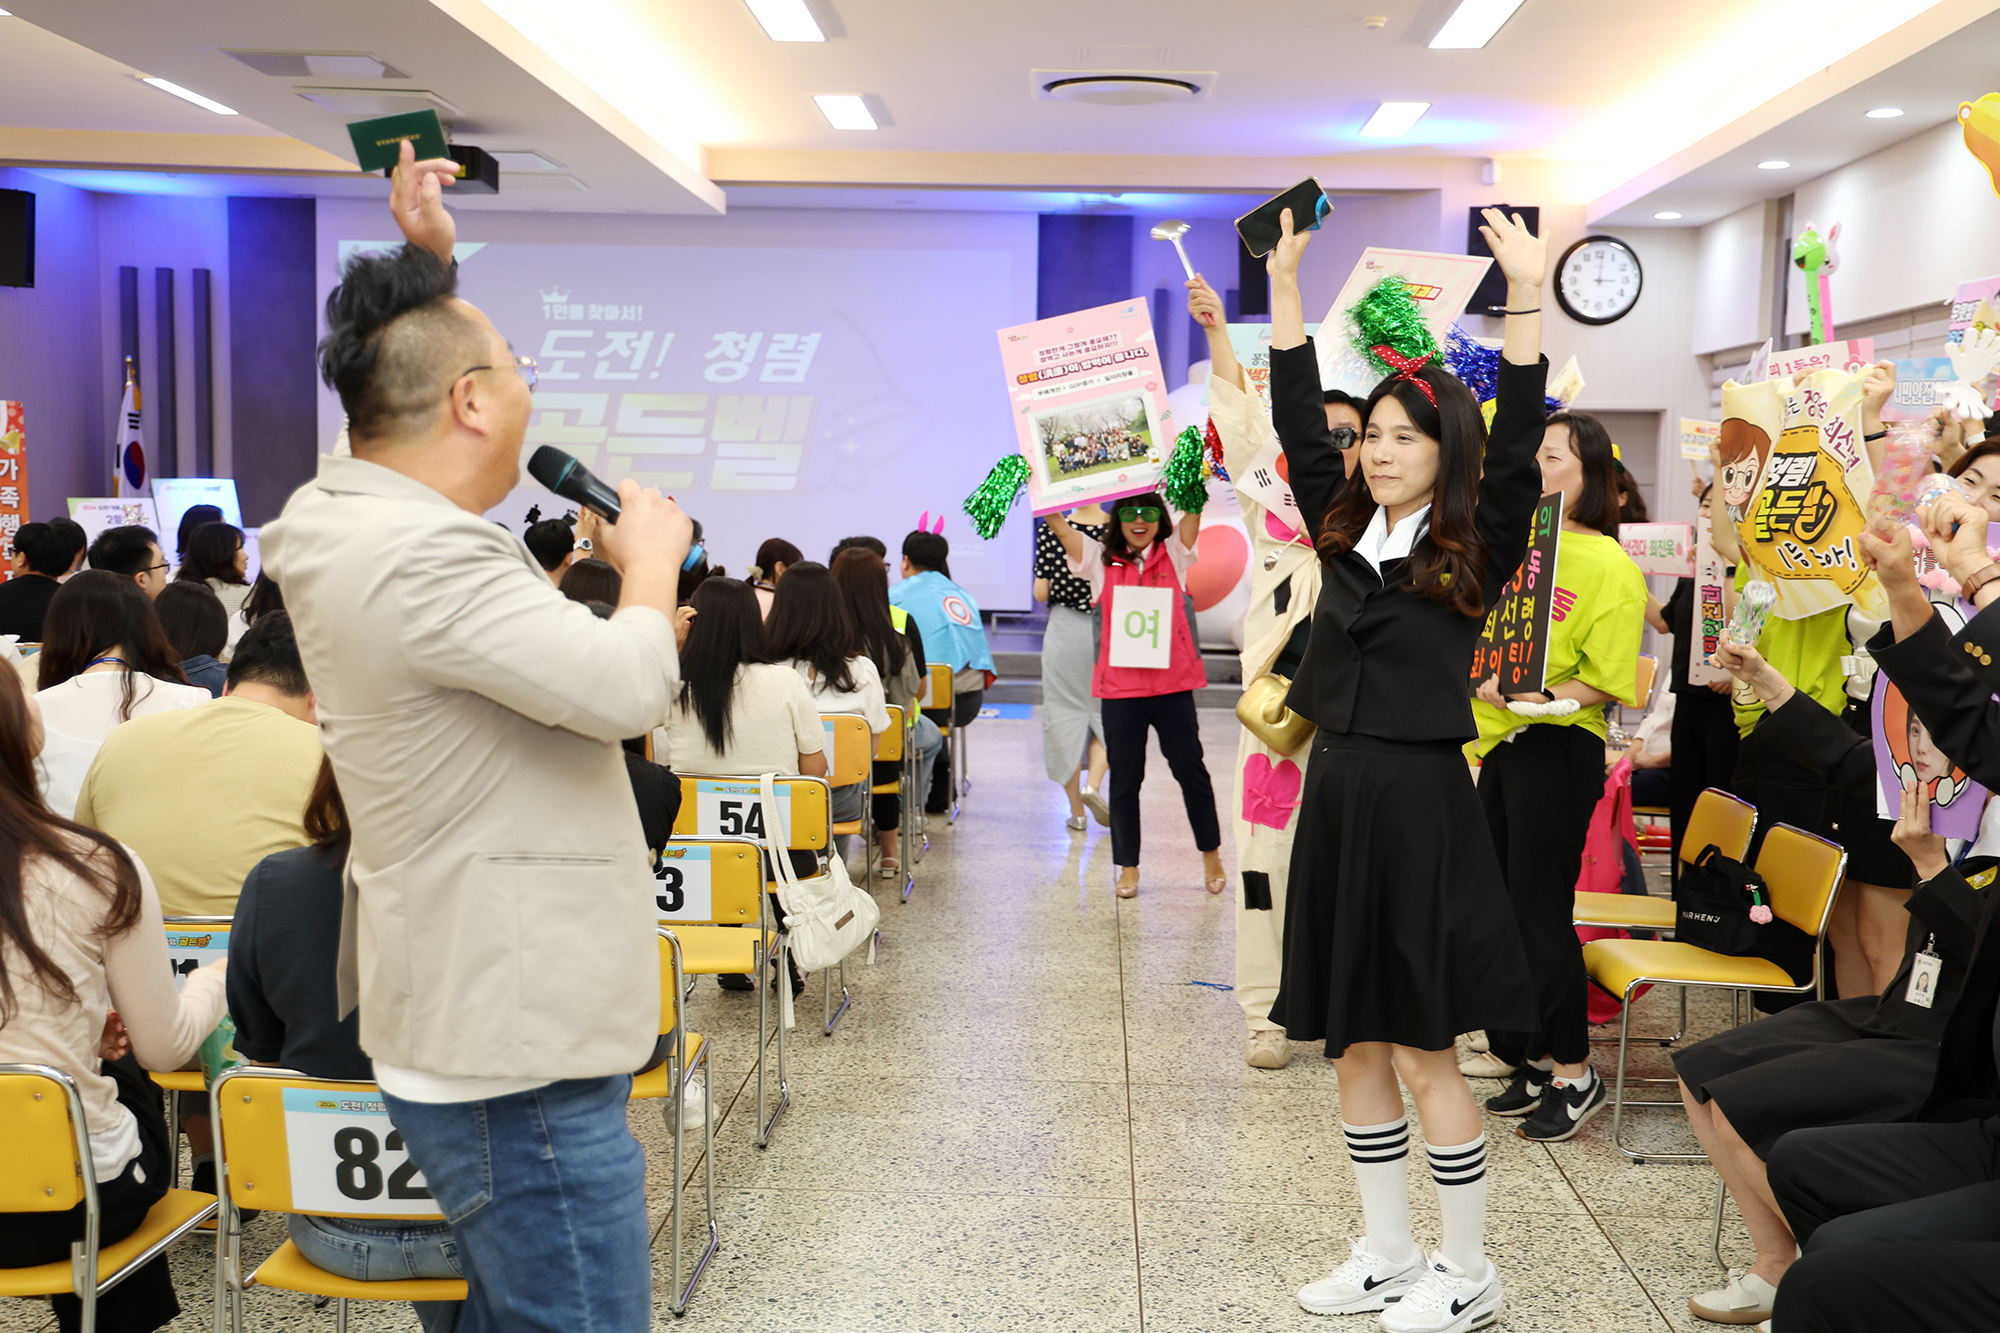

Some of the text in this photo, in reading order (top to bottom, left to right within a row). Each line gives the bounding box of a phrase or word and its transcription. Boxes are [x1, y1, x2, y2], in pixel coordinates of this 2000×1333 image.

[537, 329, 822, 383] 도전! 청렴
[1124, 609, 1160, 649] 여
[719, 800, 766, 839] 54
[341, 1100, 366, 1112] 도전!
[334, 1126, 435, 1201] 82
